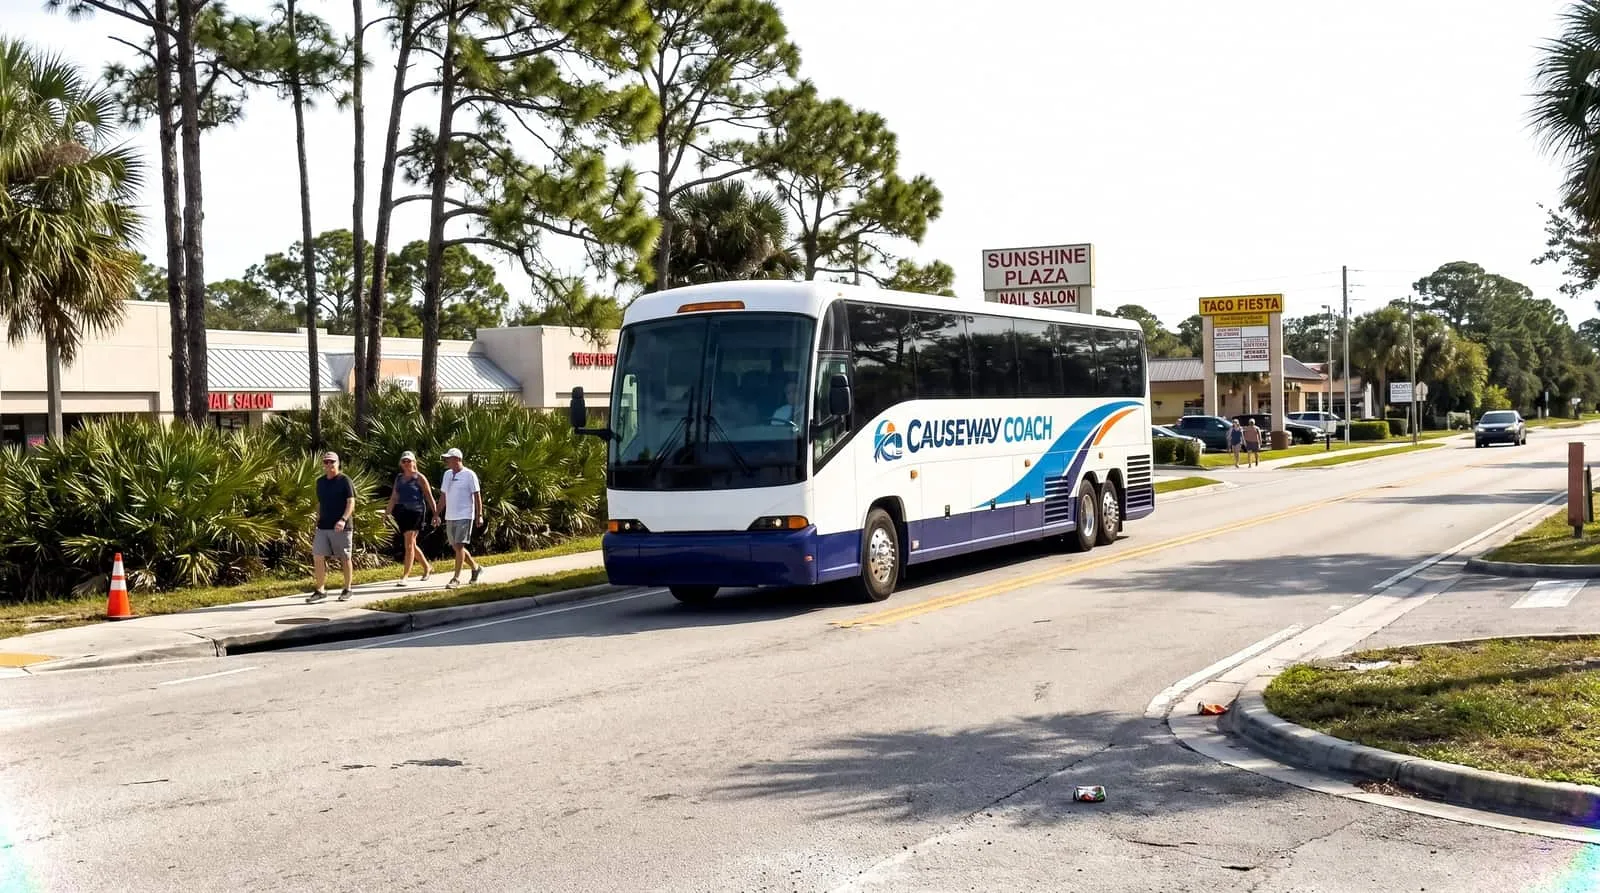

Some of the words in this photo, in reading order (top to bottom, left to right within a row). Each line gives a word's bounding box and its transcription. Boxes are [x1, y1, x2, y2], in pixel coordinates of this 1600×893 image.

[987, 247, 1087, 268] SUNSHINE
[1005, 267, 1069, 286] PLAZA
[1000, 291, 1029, 306] NAIL
[1033, 289, 1076, 305] SALON
[1202, 299, 1234, 313] TACO
[1237, 297, 1279, 311] FIESTA
[234, 392, 274, 409] SALON
[907, 417, 1002, 453] CAUSEWAY
[1004, 415, 1053, 443] COACH
